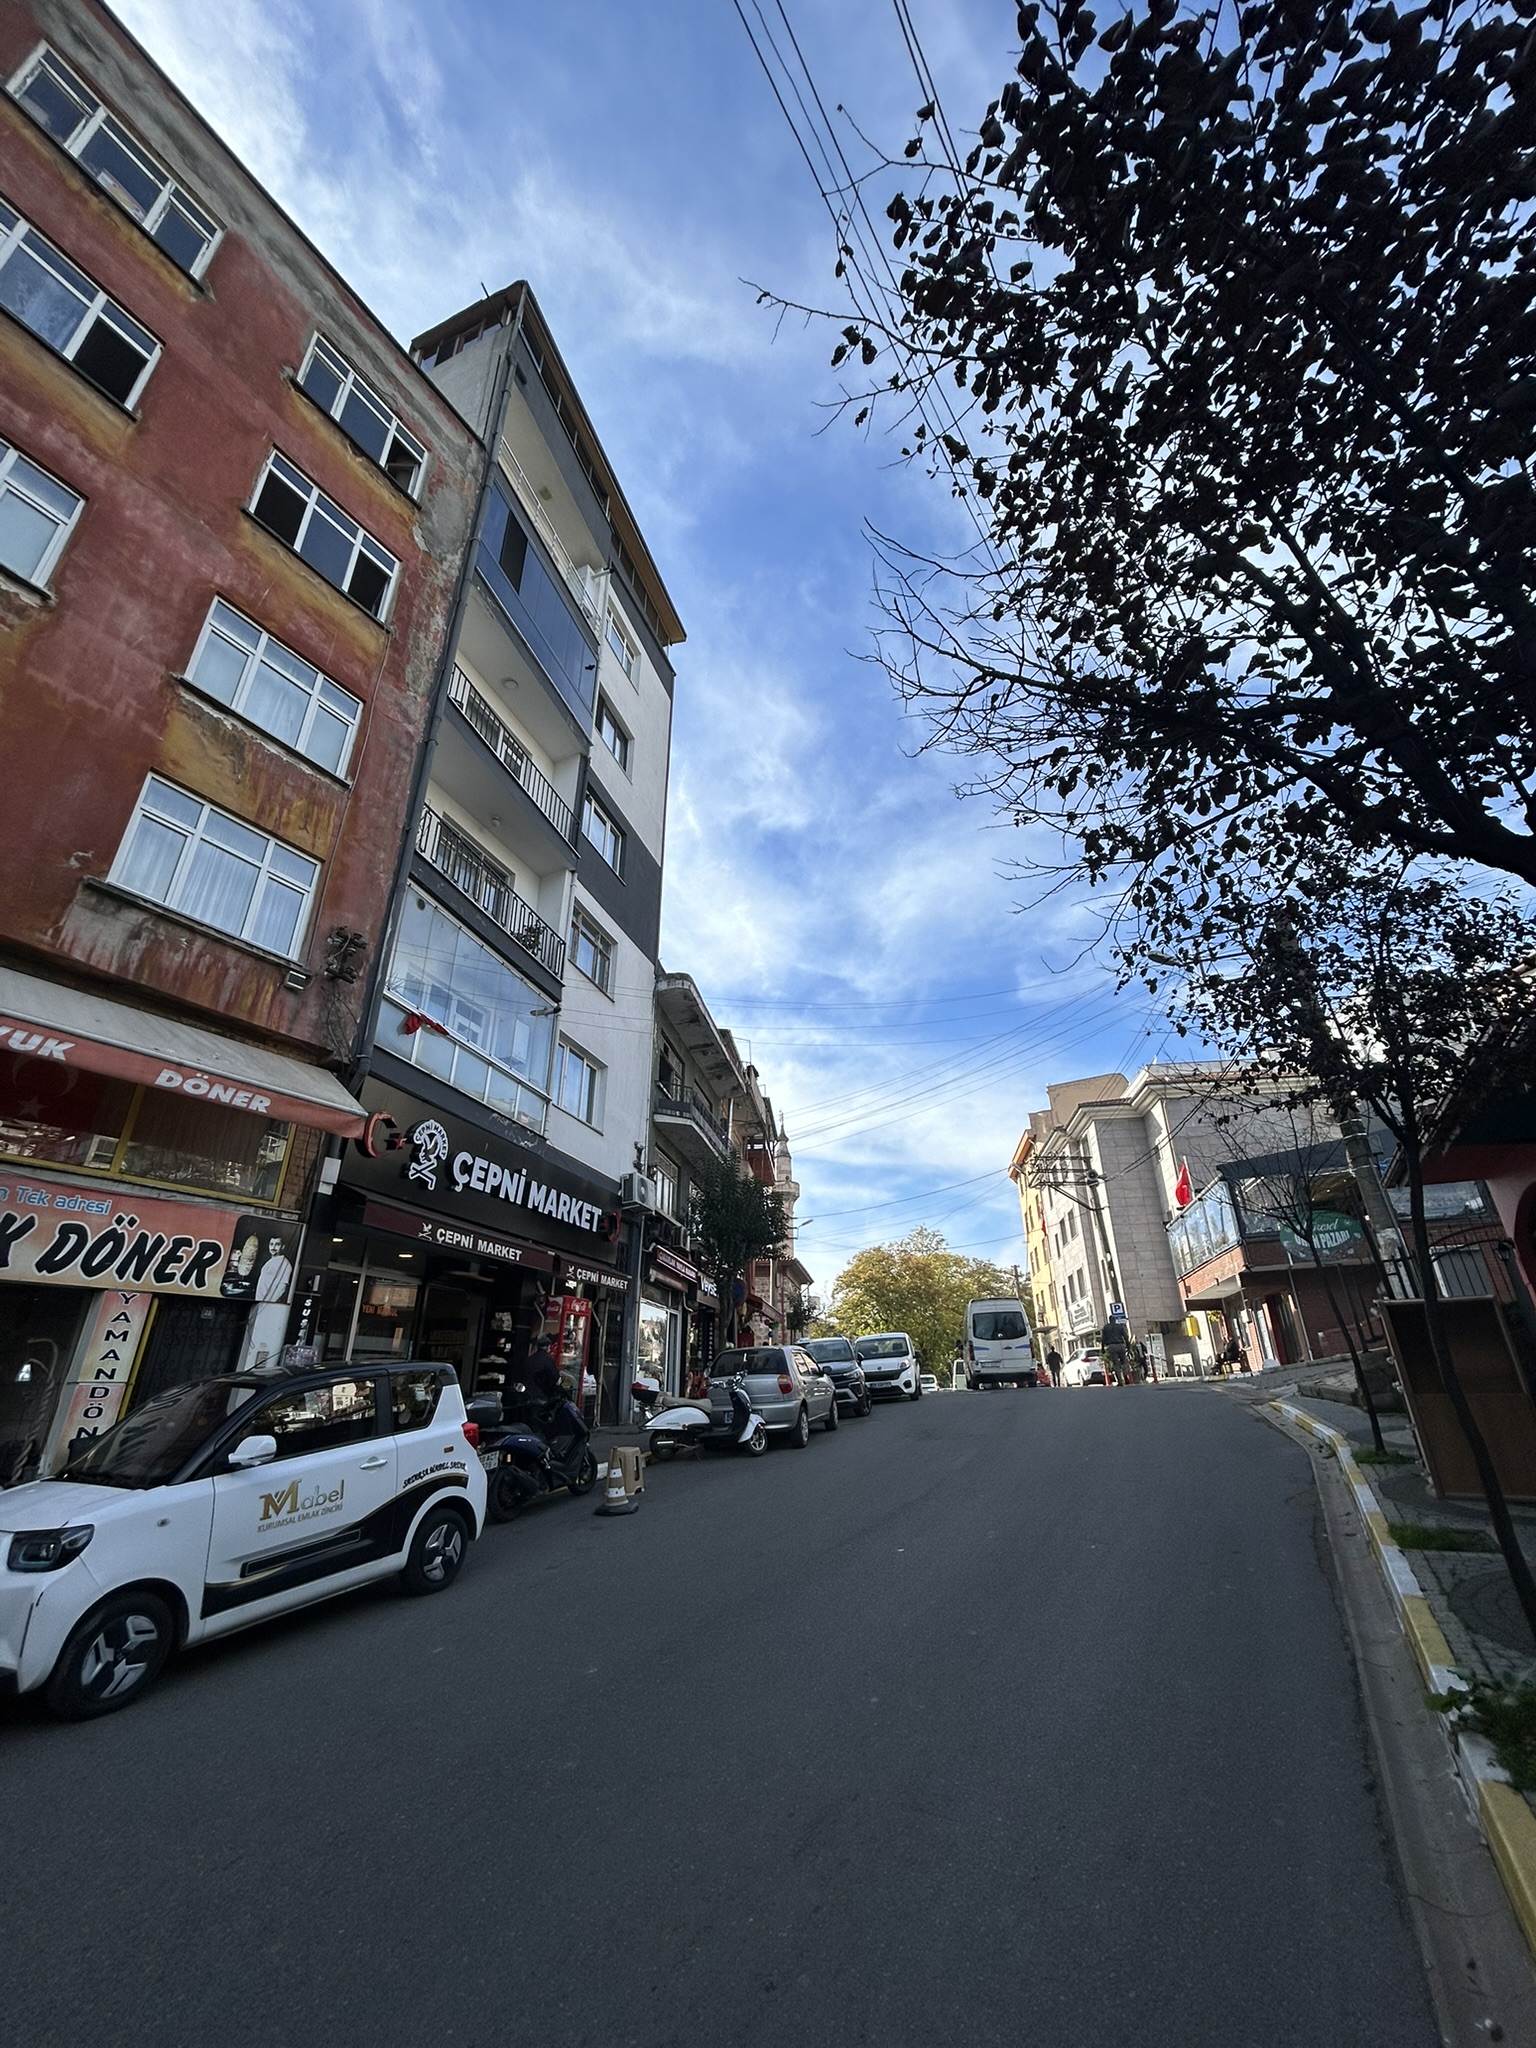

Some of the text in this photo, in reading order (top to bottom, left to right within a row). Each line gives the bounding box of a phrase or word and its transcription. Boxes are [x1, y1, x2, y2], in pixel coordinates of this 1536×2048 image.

[155, 1068, 272, 1113] DÖNER
[16, 1186, 52, 1207] Tek
[54, 1195, 113, 1216] adresi
[453, 1151, 602, 1232] ÇEPNİ MARKET
[34, 1213, 223, 1290] DÖNER
[436, 1228, 523, 1261] ÇEPNİ MARKET
[1320, 1229, 1351, 1249] PAZARI
[576, 1268, 629, 1290] ÇEPNİ MARKET
[259, 1479, 345, 1521] Mabel
[257, 1516, 297, 1534] KURUMSAL
[297, 1509, 320, 1523] EMLAK
